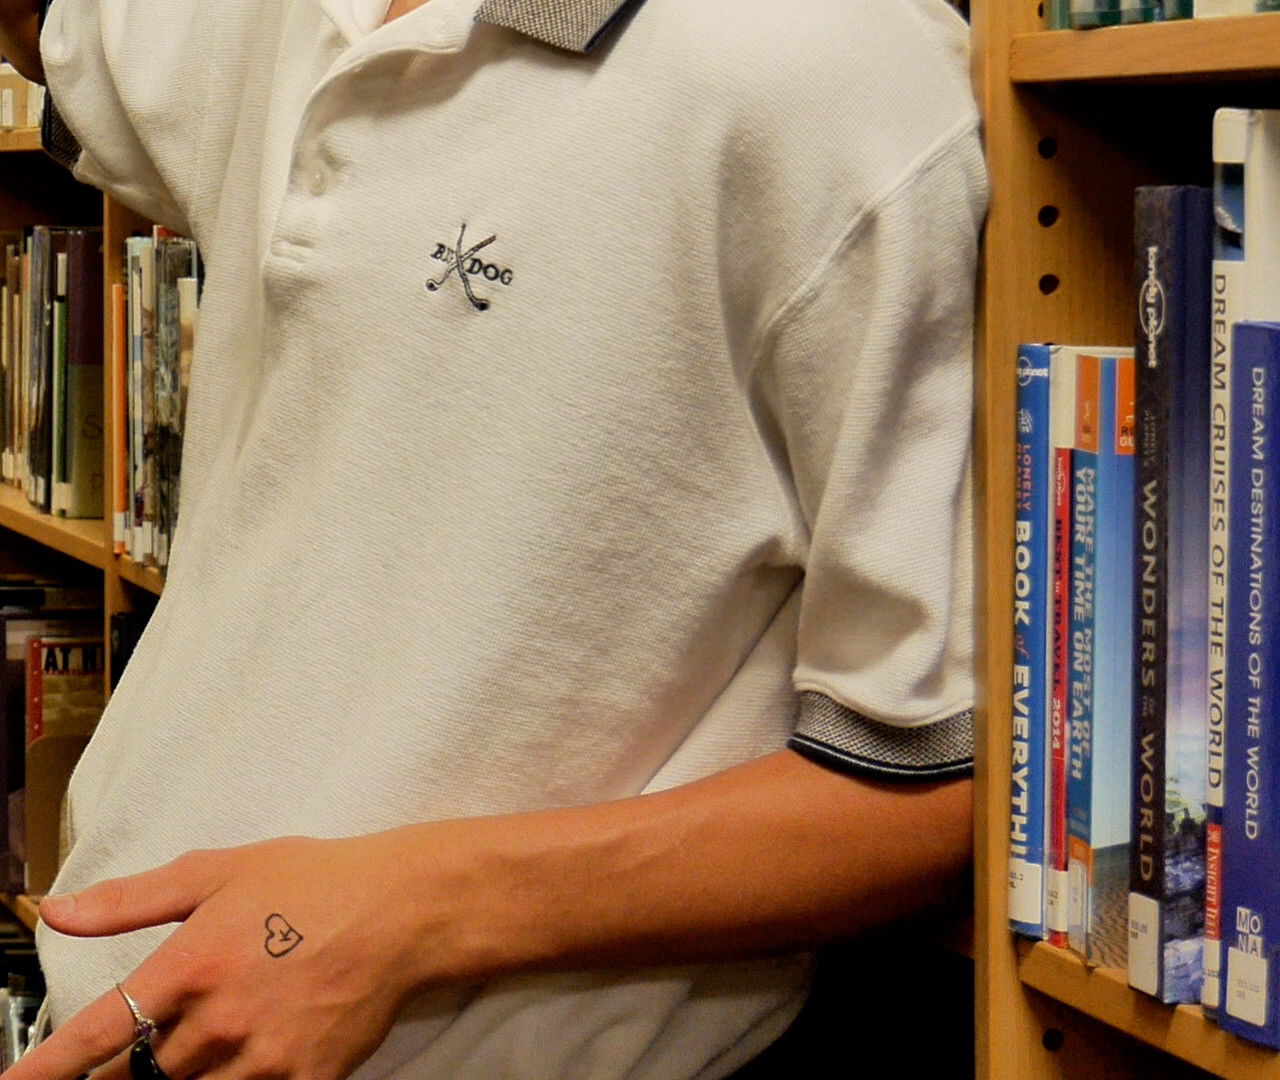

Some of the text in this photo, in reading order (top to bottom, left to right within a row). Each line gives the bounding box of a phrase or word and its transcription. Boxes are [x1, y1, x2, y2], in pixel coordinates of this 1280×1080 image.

[465, 257, 513, 286] DOG
[1145, 246, 1158, 369] lonely planet
[1022, 443, 1031, 512] LONELY
[1083, 467, 1096, 554] MAKE
[1014, 519, 1031, 625] BOOK
[1208, 274, 1226, 789] DREAM CRUISES OF THE WORLD
[1071, 466, 1087, 780] YOUR TIME ON EARTH
[1083, 562, 1095, 617] THE
[1141, 479, 1159, 686] WONDERS
[1244, 367, 1265, 840] DREAM DESTINATIONS OF THE WORLD
[44, 647, 72, 671] AT
[1053, 594, 1063, 691] TRAVEL
[1082, 628, 1094, 710] MOST
[1010, 663, 1029, 863] EVERYTHI
[1050, 696, 1062, 750] 2014
[1139, 731, 1157, 883] WORLD
